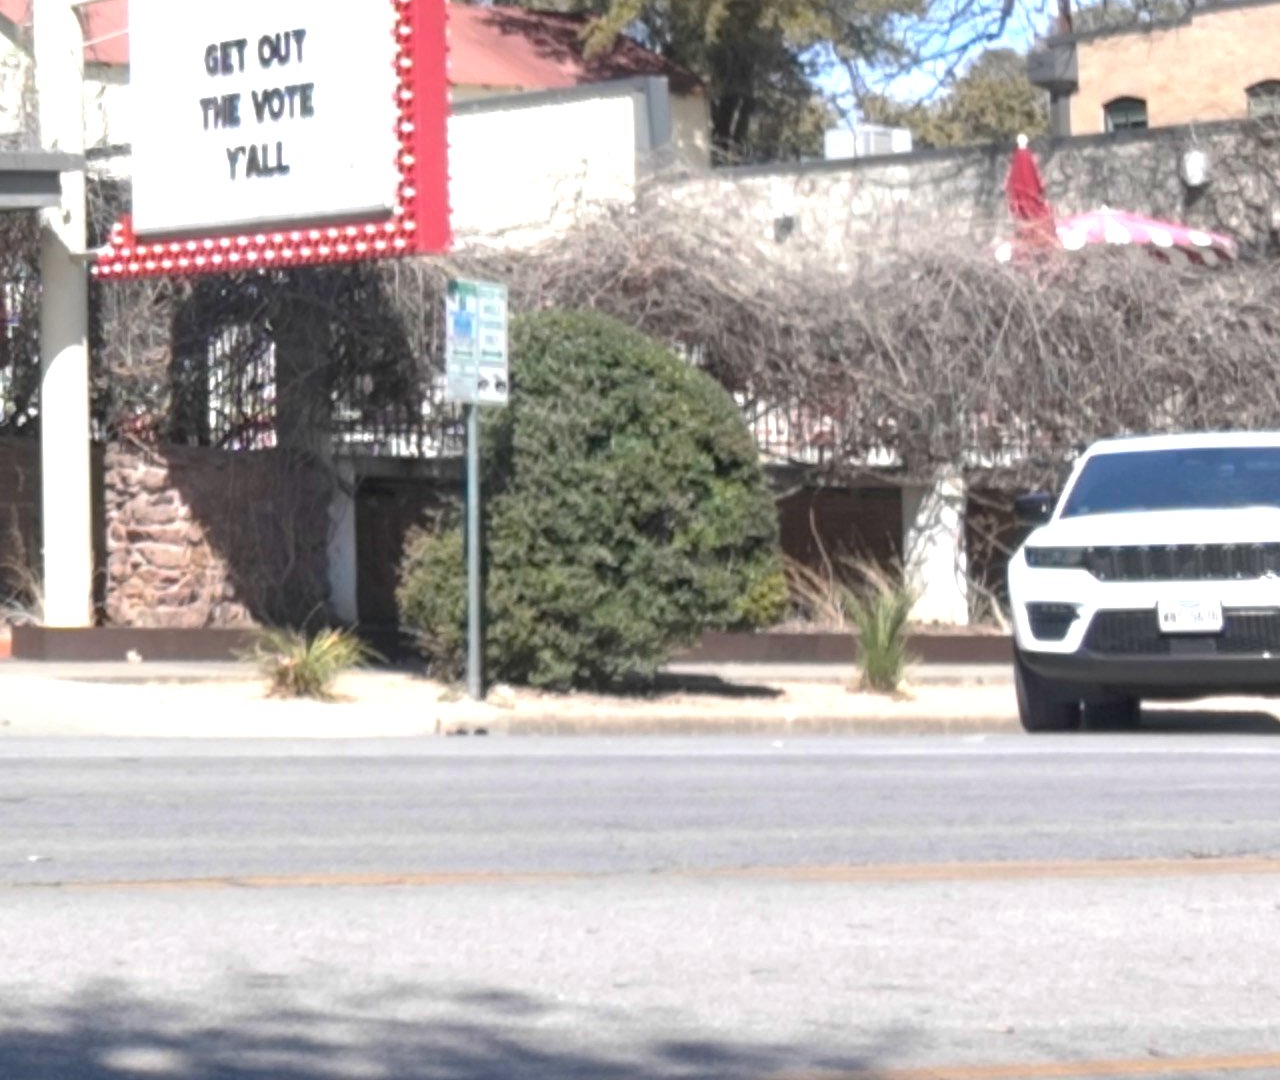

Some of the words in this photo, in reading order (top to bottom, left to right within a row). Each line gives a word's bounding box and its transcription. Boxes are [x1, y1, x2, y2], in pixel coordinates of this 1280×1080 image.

[205, 38, 247, 77] GET
[258, 28, 307, 69] OUT
[199, 93, 241, 131] THE
[251, 83, 315, 124] VOTE
[226, 141, 290, 181] Y'ALL
